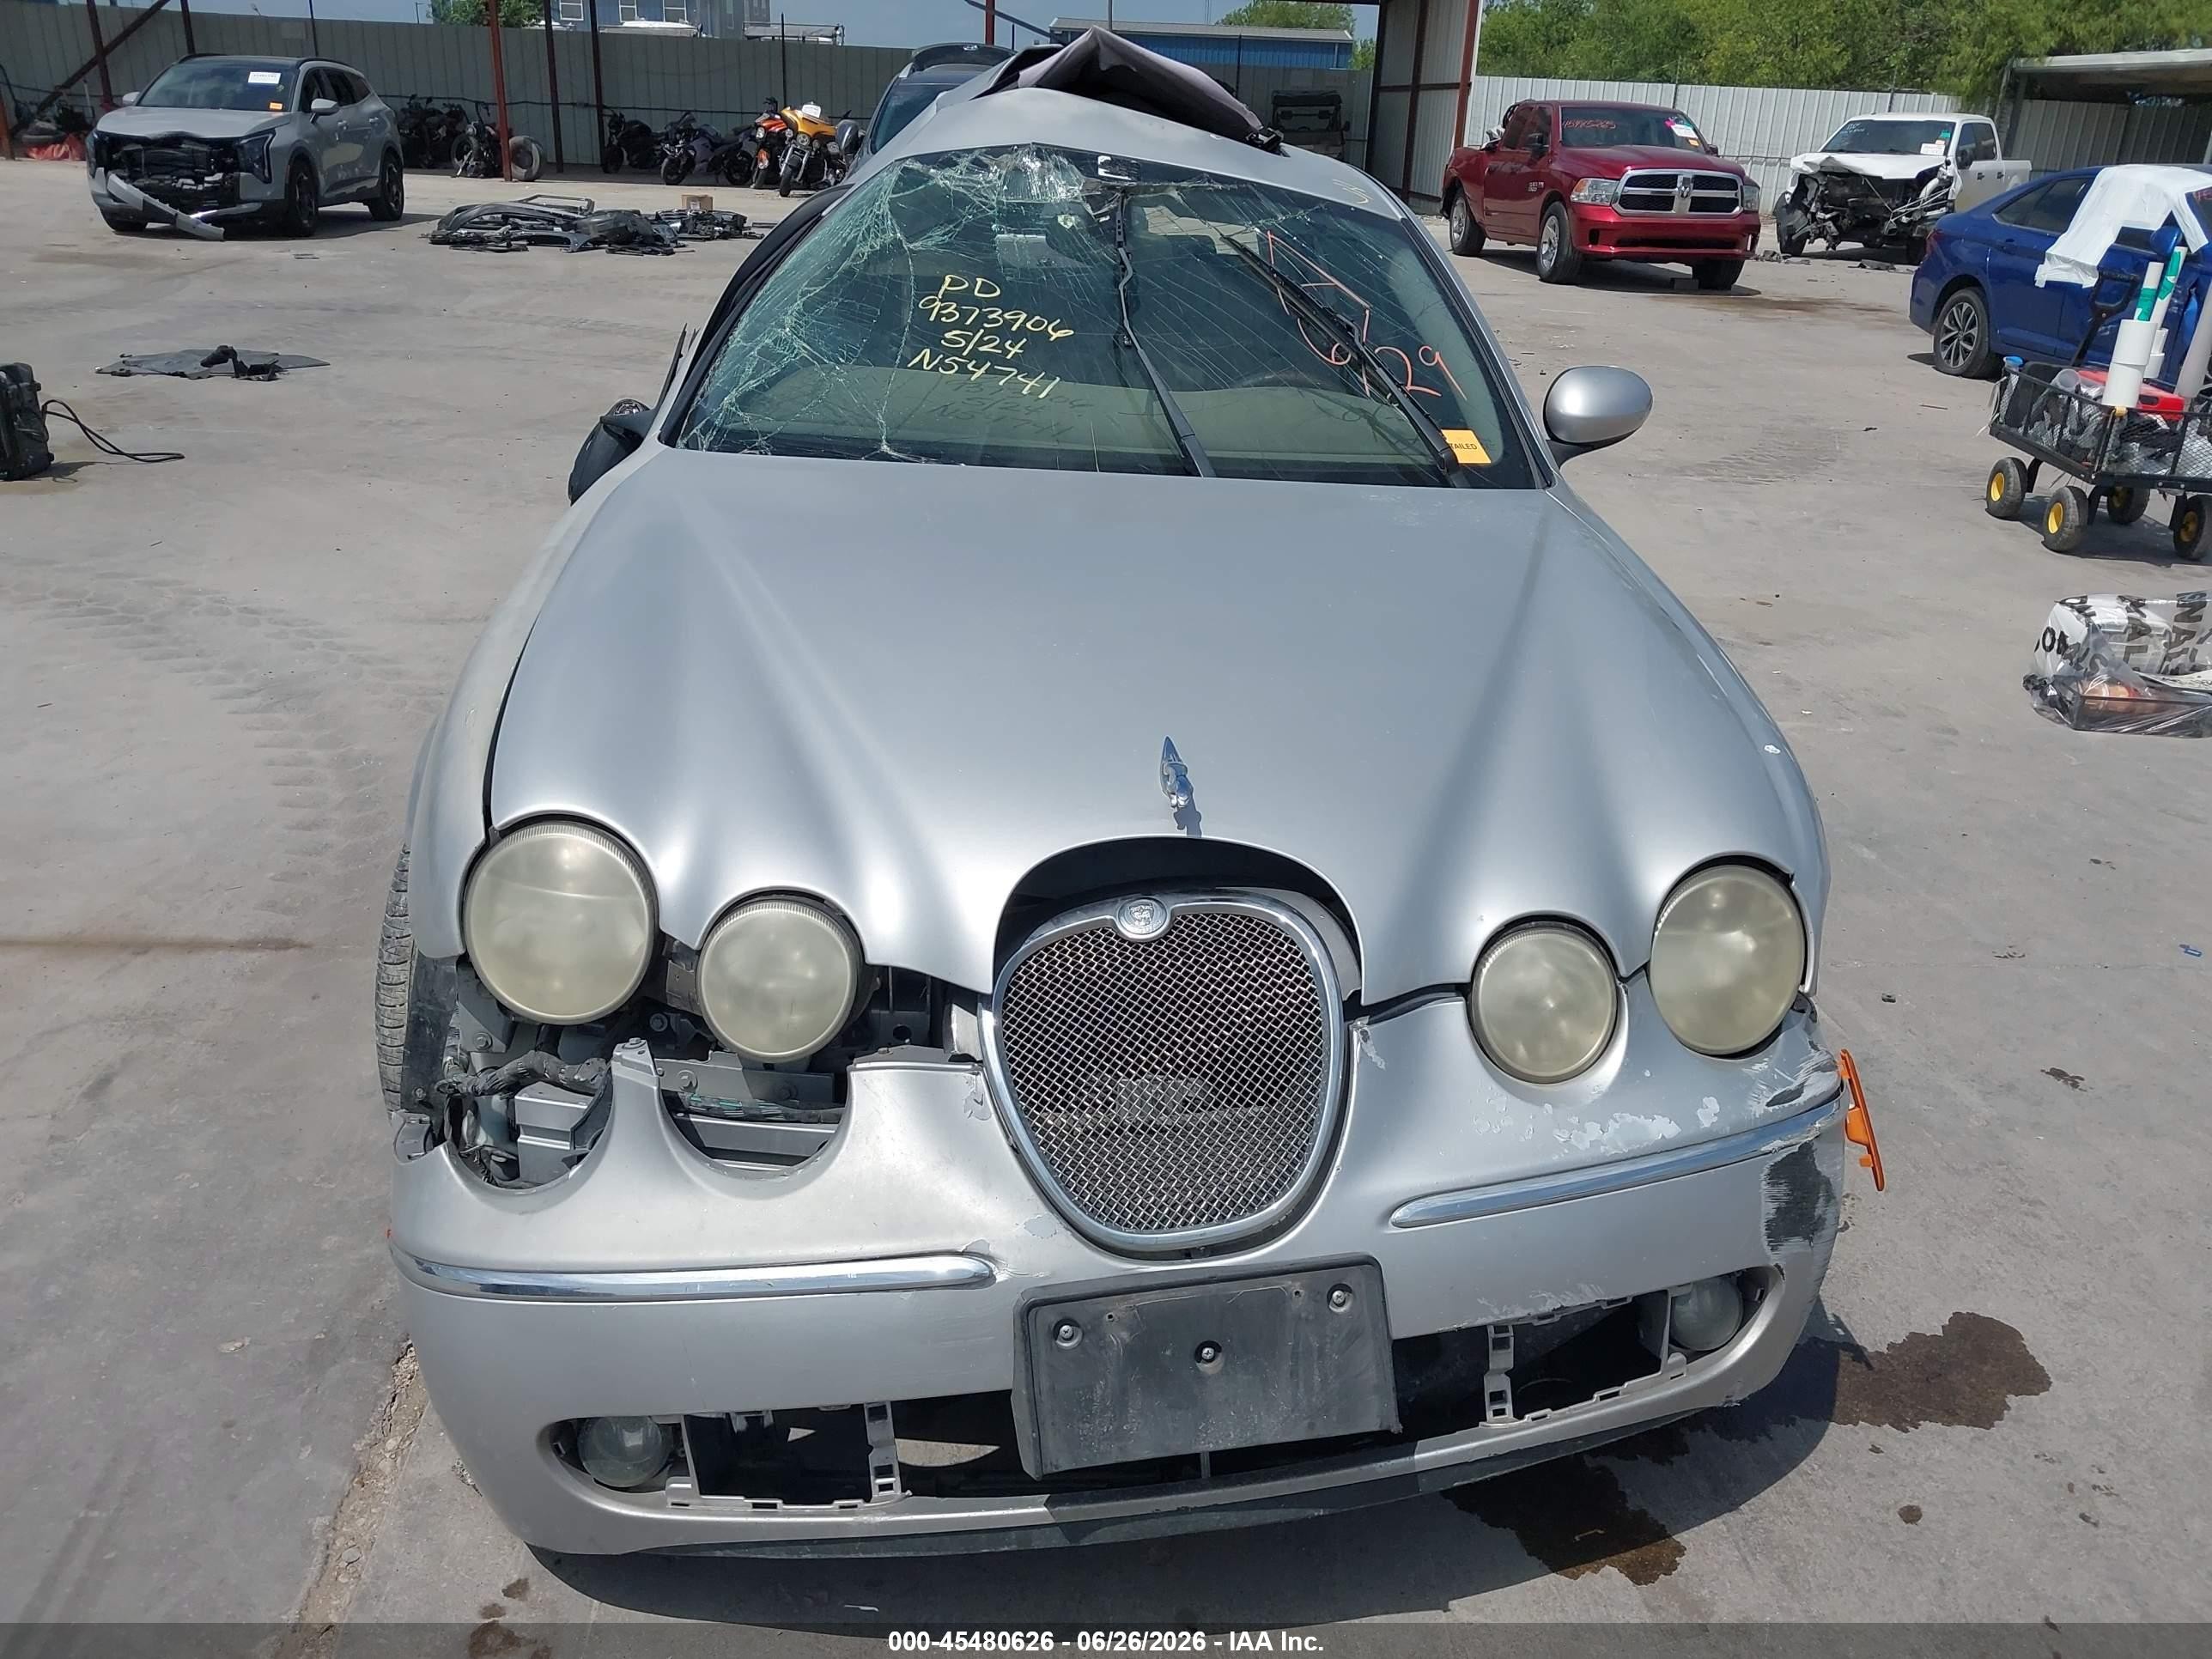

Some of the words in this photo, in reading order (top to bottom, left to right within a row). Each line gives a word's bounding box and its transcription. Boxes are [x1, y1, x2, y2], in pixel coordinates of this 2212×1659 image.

[937, 274, 1001, 299] PD
[918, 295, 1075, 342] 9373906
[940, 328, 1028, 360] 5/24
[907, 348, 1060, 399] N54741
